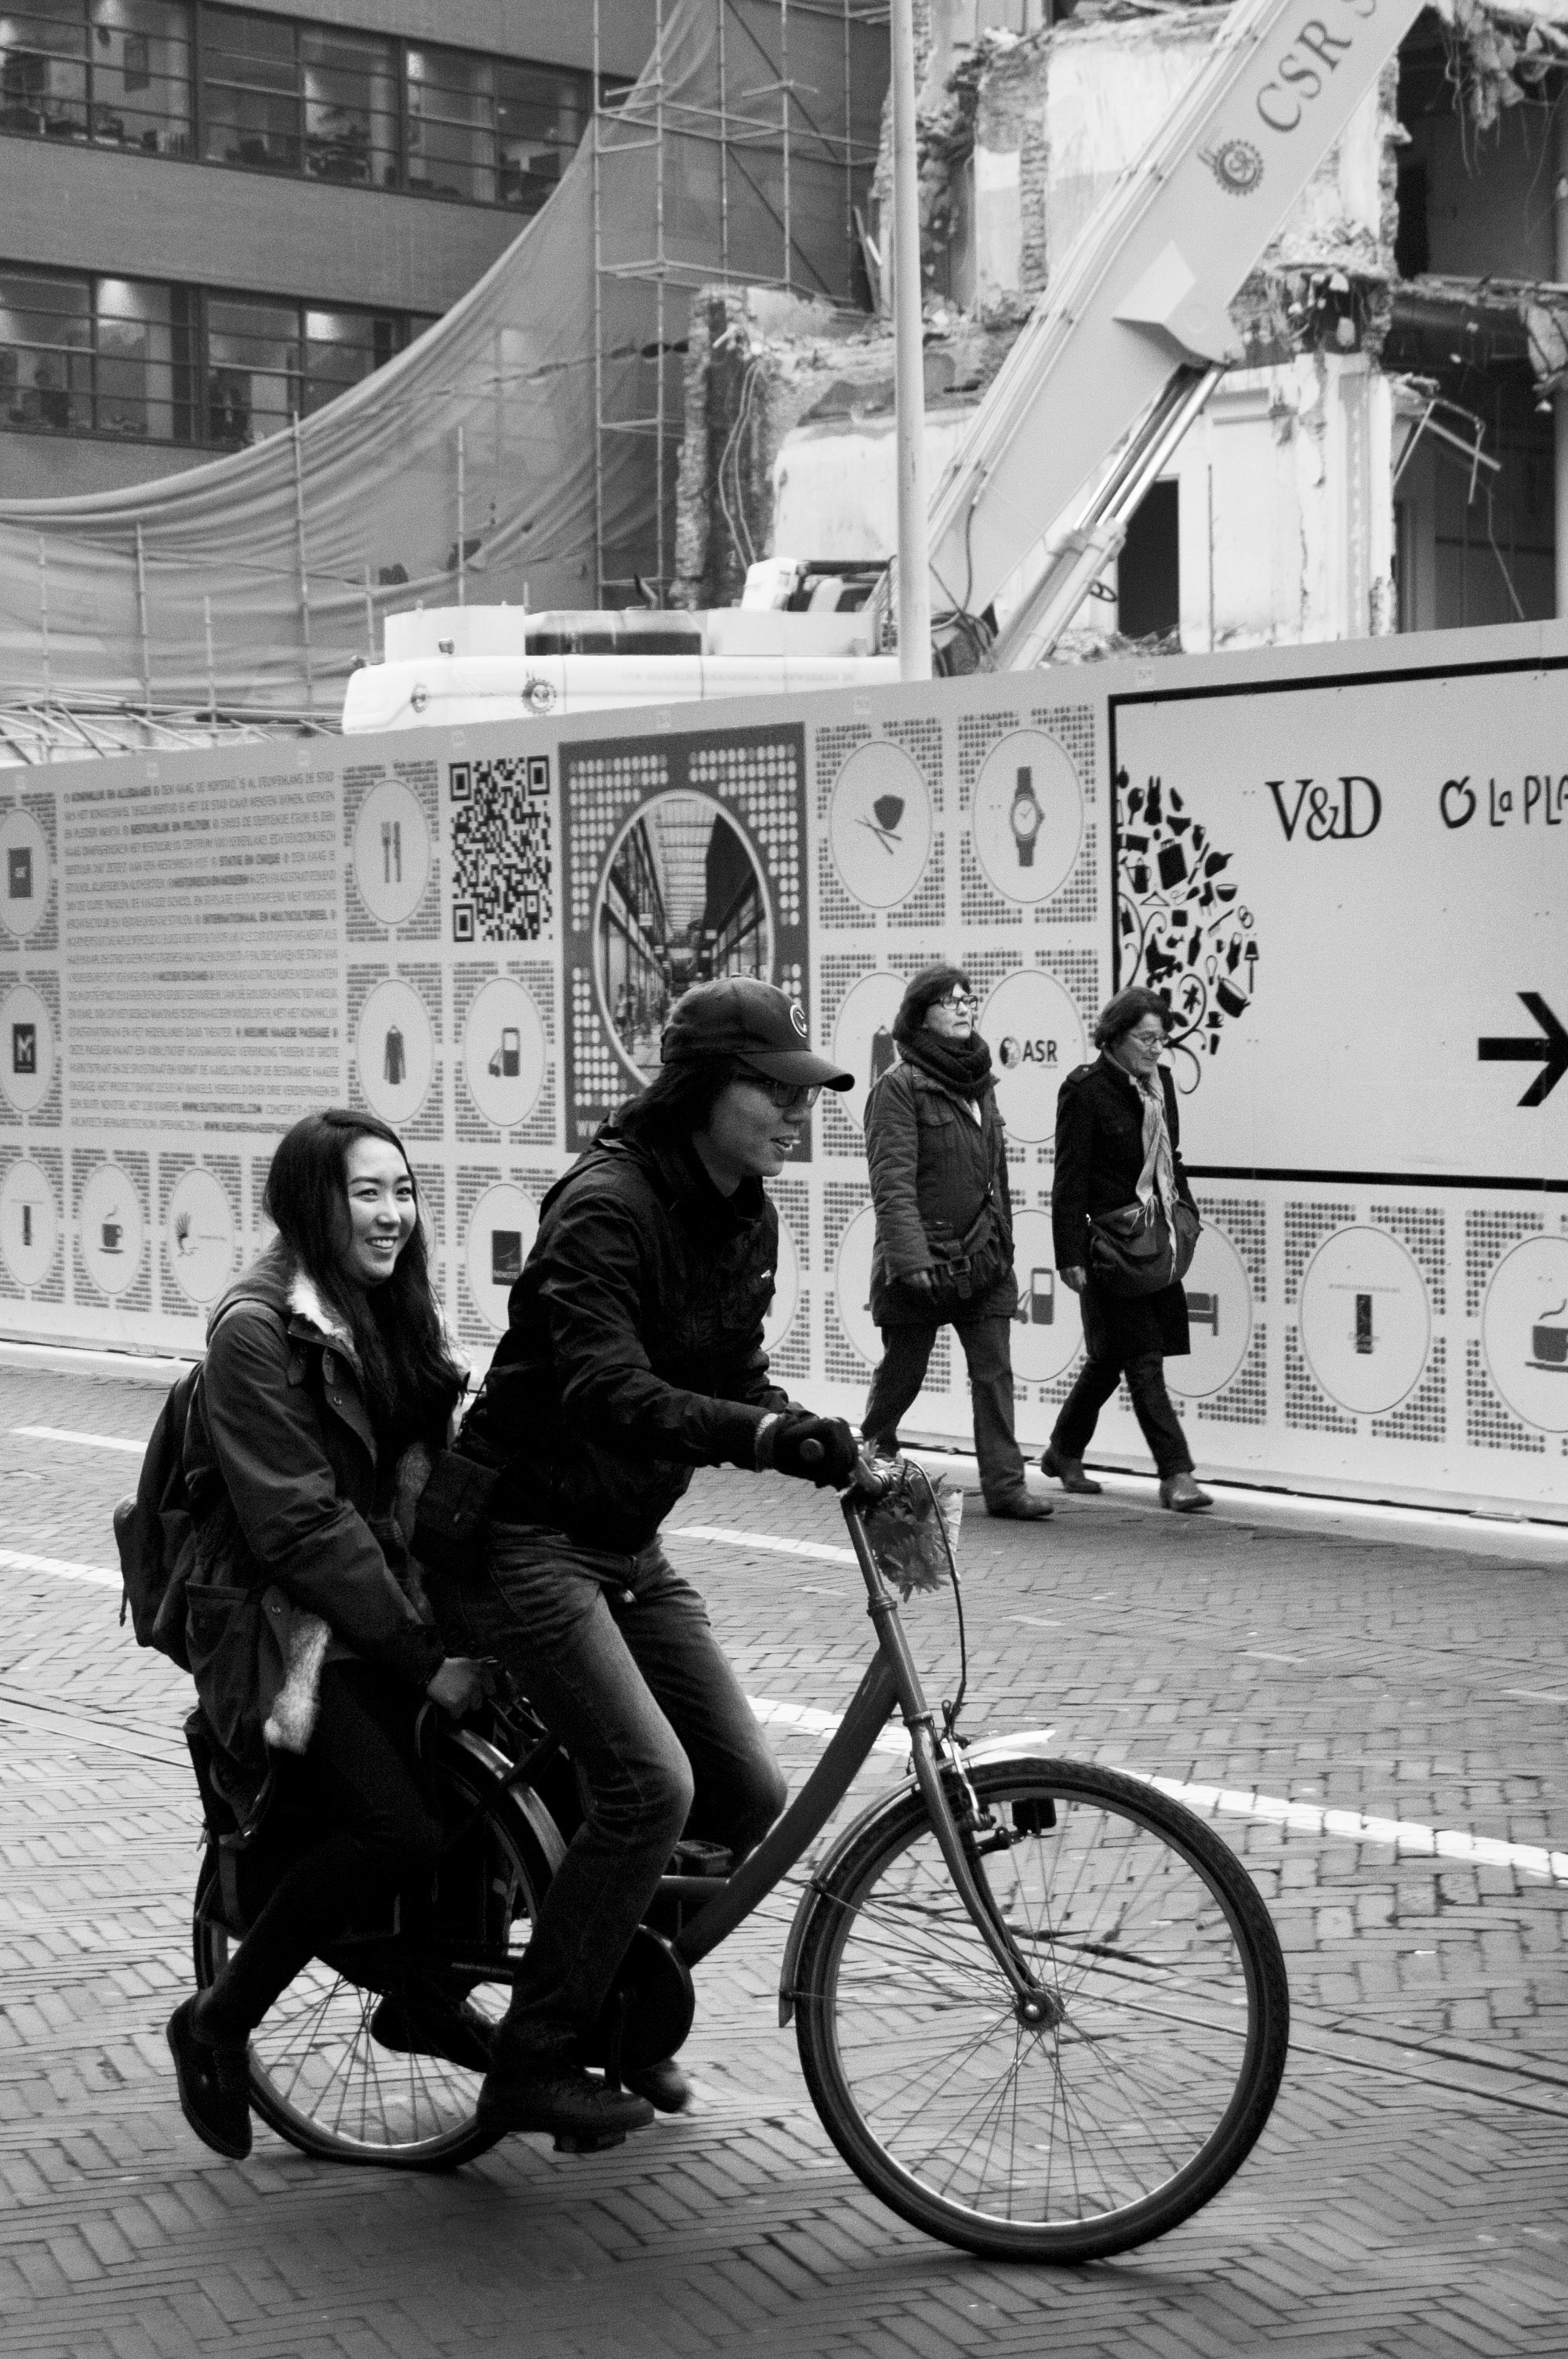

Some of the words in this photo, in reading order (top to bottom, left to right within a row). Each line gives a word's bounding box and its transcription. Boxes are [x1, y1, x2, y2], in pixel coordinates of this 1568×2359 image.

[1257, 19, 1352, 133] CSR
[1265, 776, 1382, 841] V&D
[1022, 1040, 1058, 1062] ASR
